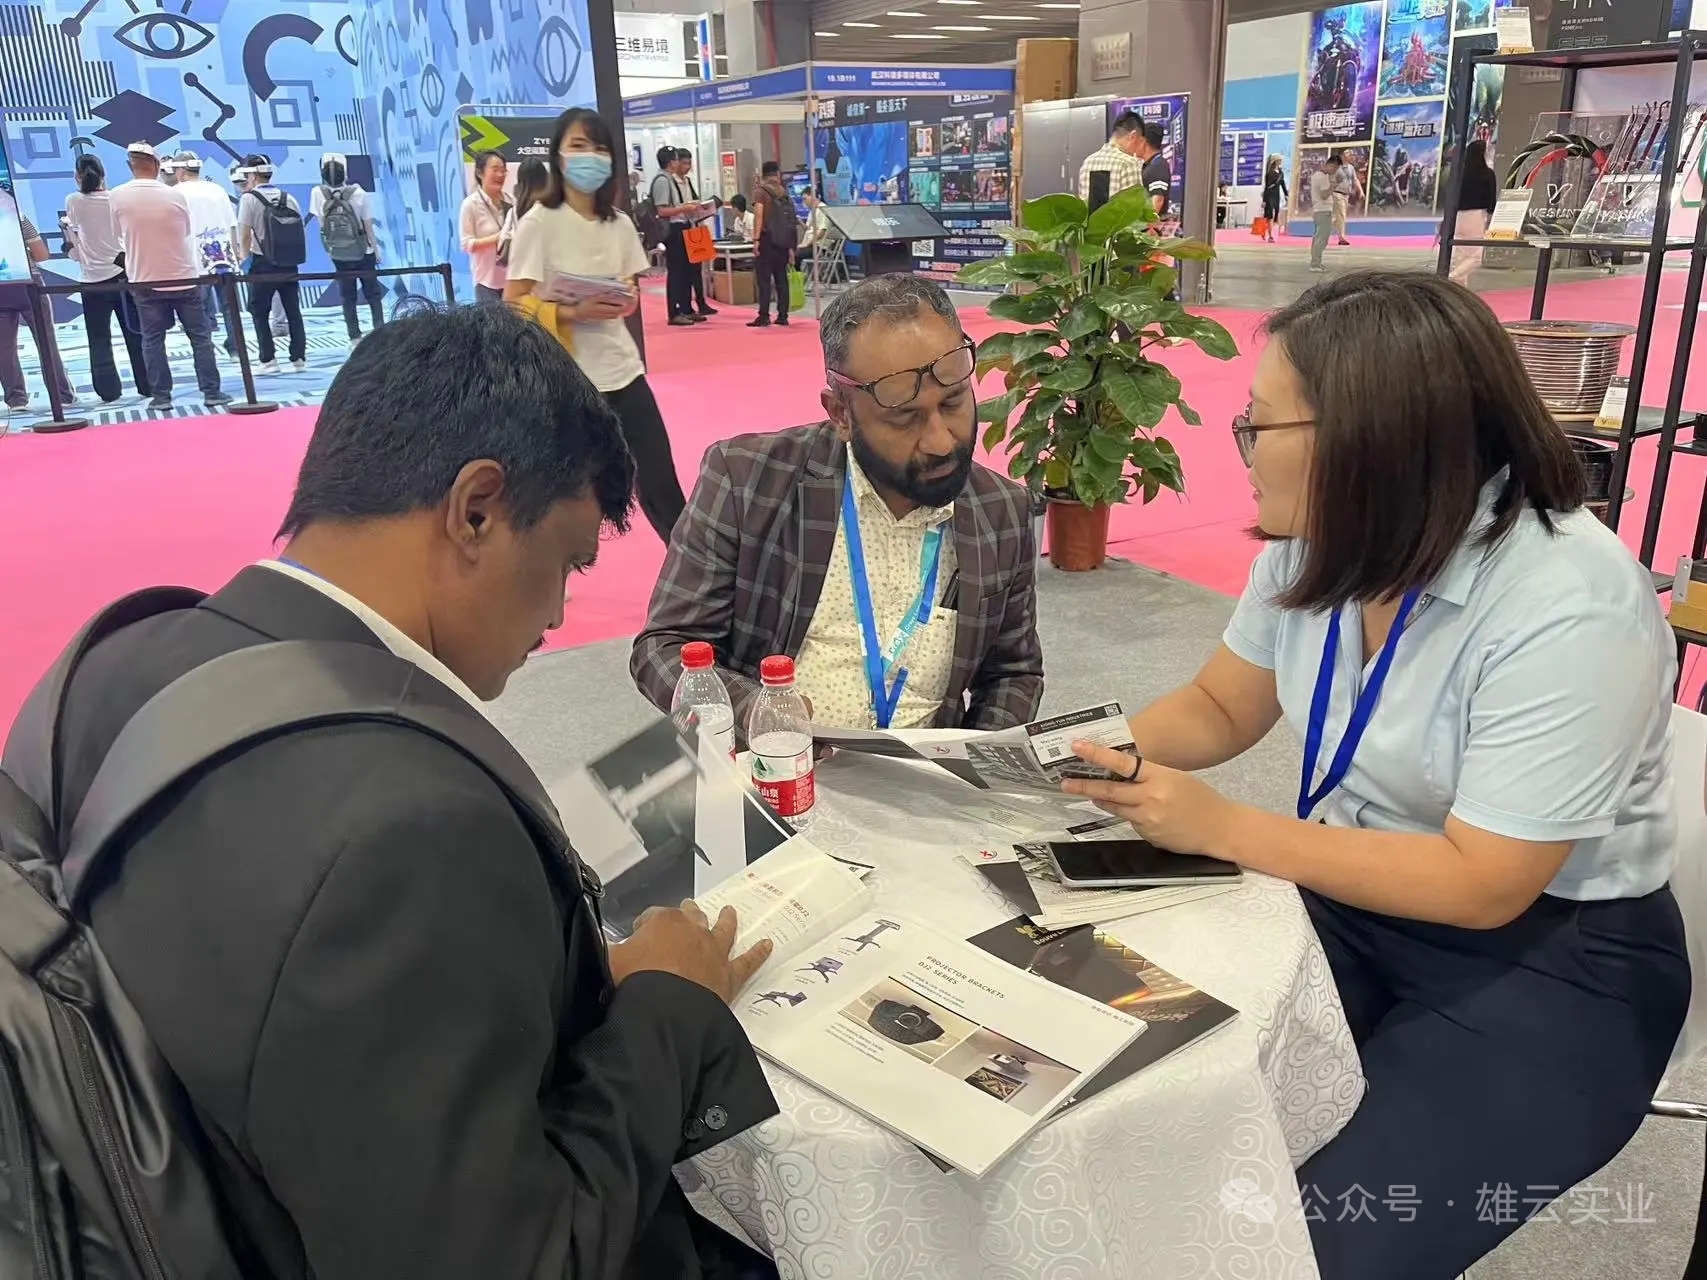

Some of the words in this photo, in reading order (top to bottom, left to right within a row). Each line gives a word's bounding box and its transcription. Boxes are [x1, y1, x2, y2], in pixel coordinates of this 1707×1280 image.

[918, 961, 931, 971] DJ2
[933, 969, 959, 985] SERIES
[926, 955, 967, 980] PROJECTOR
[967, 978, 1005, 999] BRACKETS
